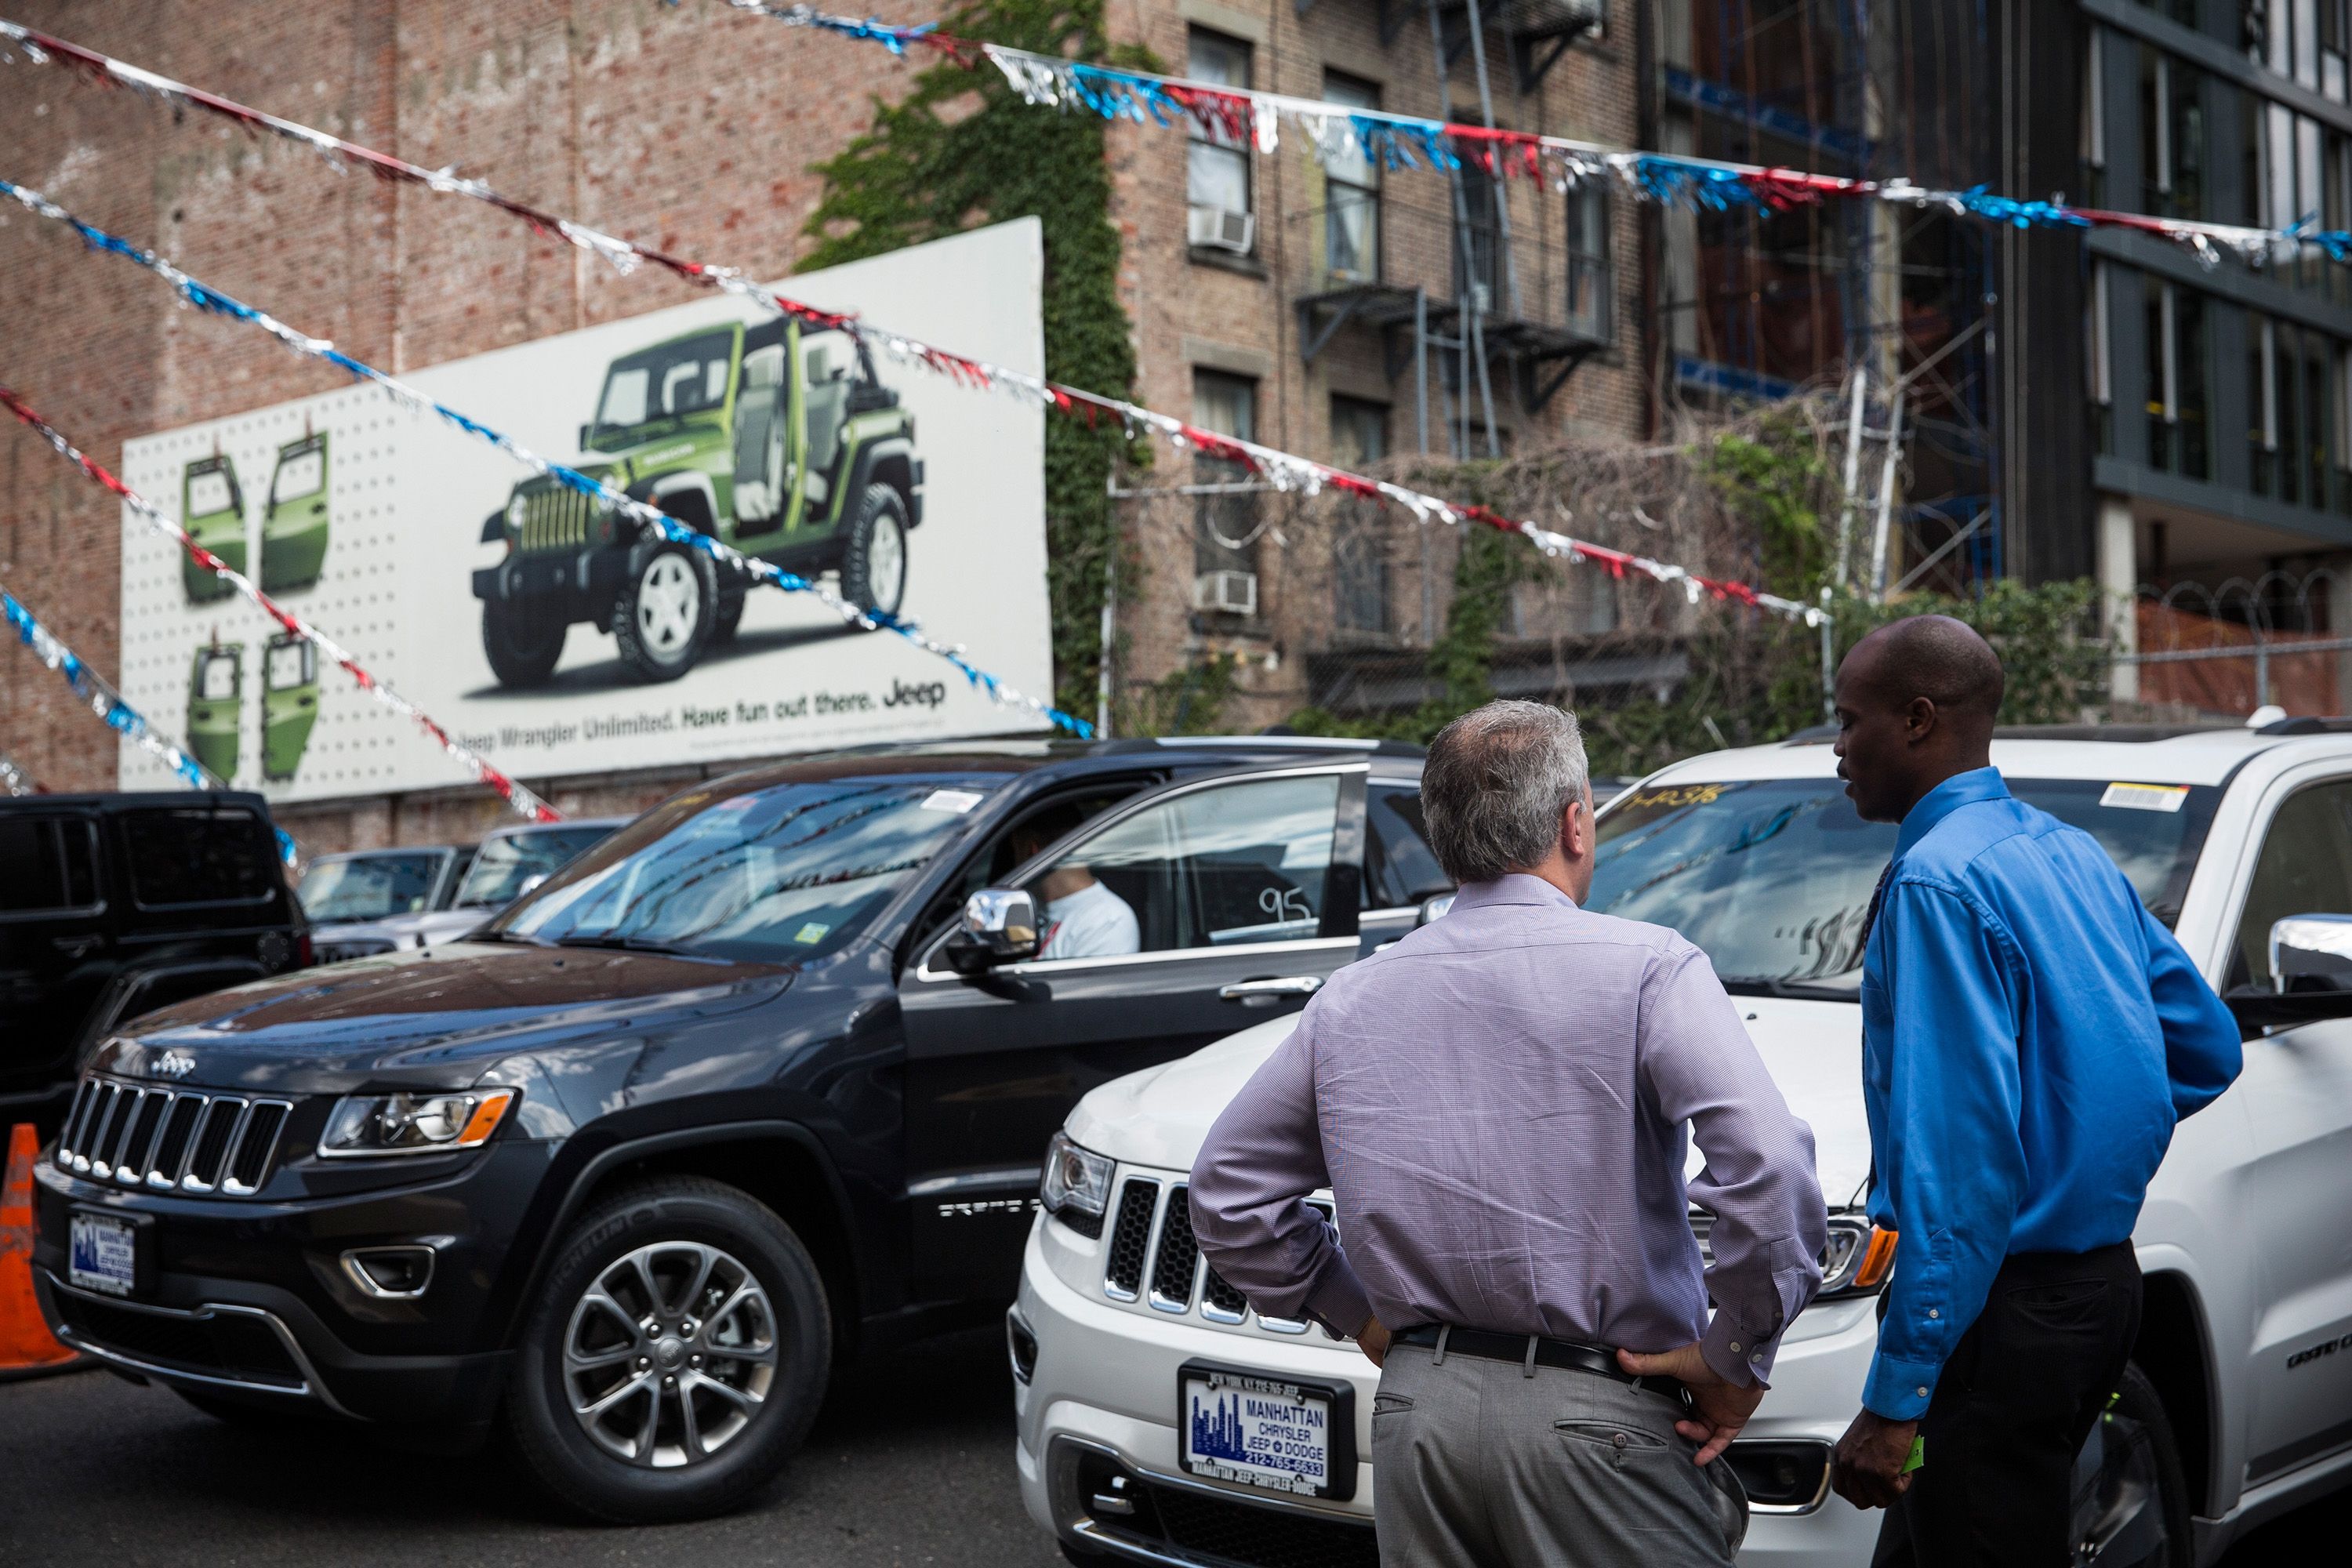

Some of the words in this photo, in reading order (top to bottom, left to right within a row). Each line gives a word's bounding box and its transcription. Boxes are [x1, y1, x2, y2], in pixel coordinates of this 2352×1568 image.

[500, 720, 578, 750] Wrangler
[583, 708, 676, 739] Unlimited.
[681, 703, 730, 729] Have
[736, 699, 769, 723] fun
[775, 694, 808, 718] out
[815, 688, 876, 715] there.
[884, 676, 946, 711] Jeep
[1258, 886, 1312, 922] 95
[151, 1051, 196, 1080] Jeep
[1246, 1399, 1323, 1428] MANHATTAN
[1258, 1422, 1311, 1443] CHRYSLER
[1247, 1436, 1270, 1450] JEEP
[1285, 1442, 1323, 1461] DODGE
[1191, 1460, 1235, 1481] MANHATTAN
[1245, 1452, 1323, 1476] 212-765-6633
